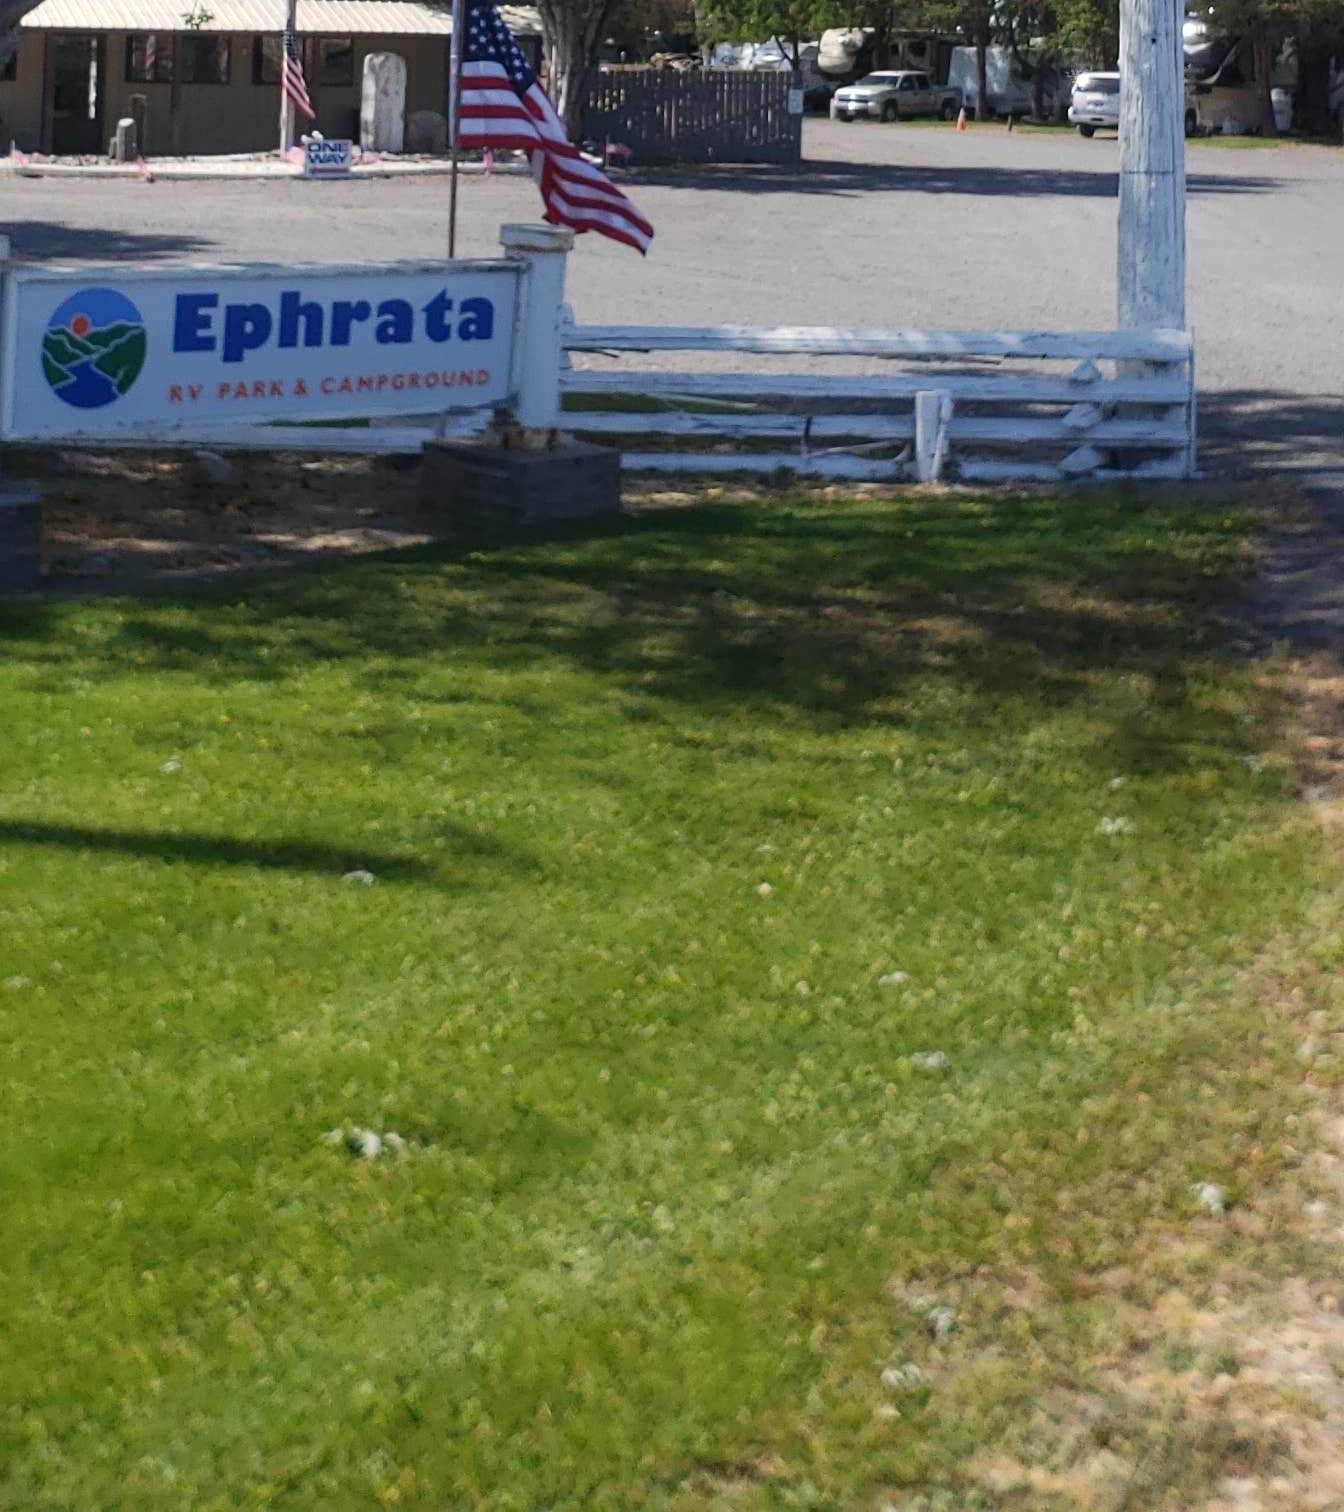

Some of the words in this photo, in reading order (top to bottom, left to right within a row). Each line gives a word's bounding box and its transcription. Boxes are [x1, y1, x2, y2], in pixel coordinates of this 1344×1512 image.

[308, 143, 349, 152] ONE
[308, 152, 348, 164] WAY
[173, 288, 494, 362] Ephrata
[167, 382, 203, 404] RV
[217, 378, 283, 400] PARK
[292, 377, 309, 396] &
[320, 369, 491, 395] CAMPGROUND
